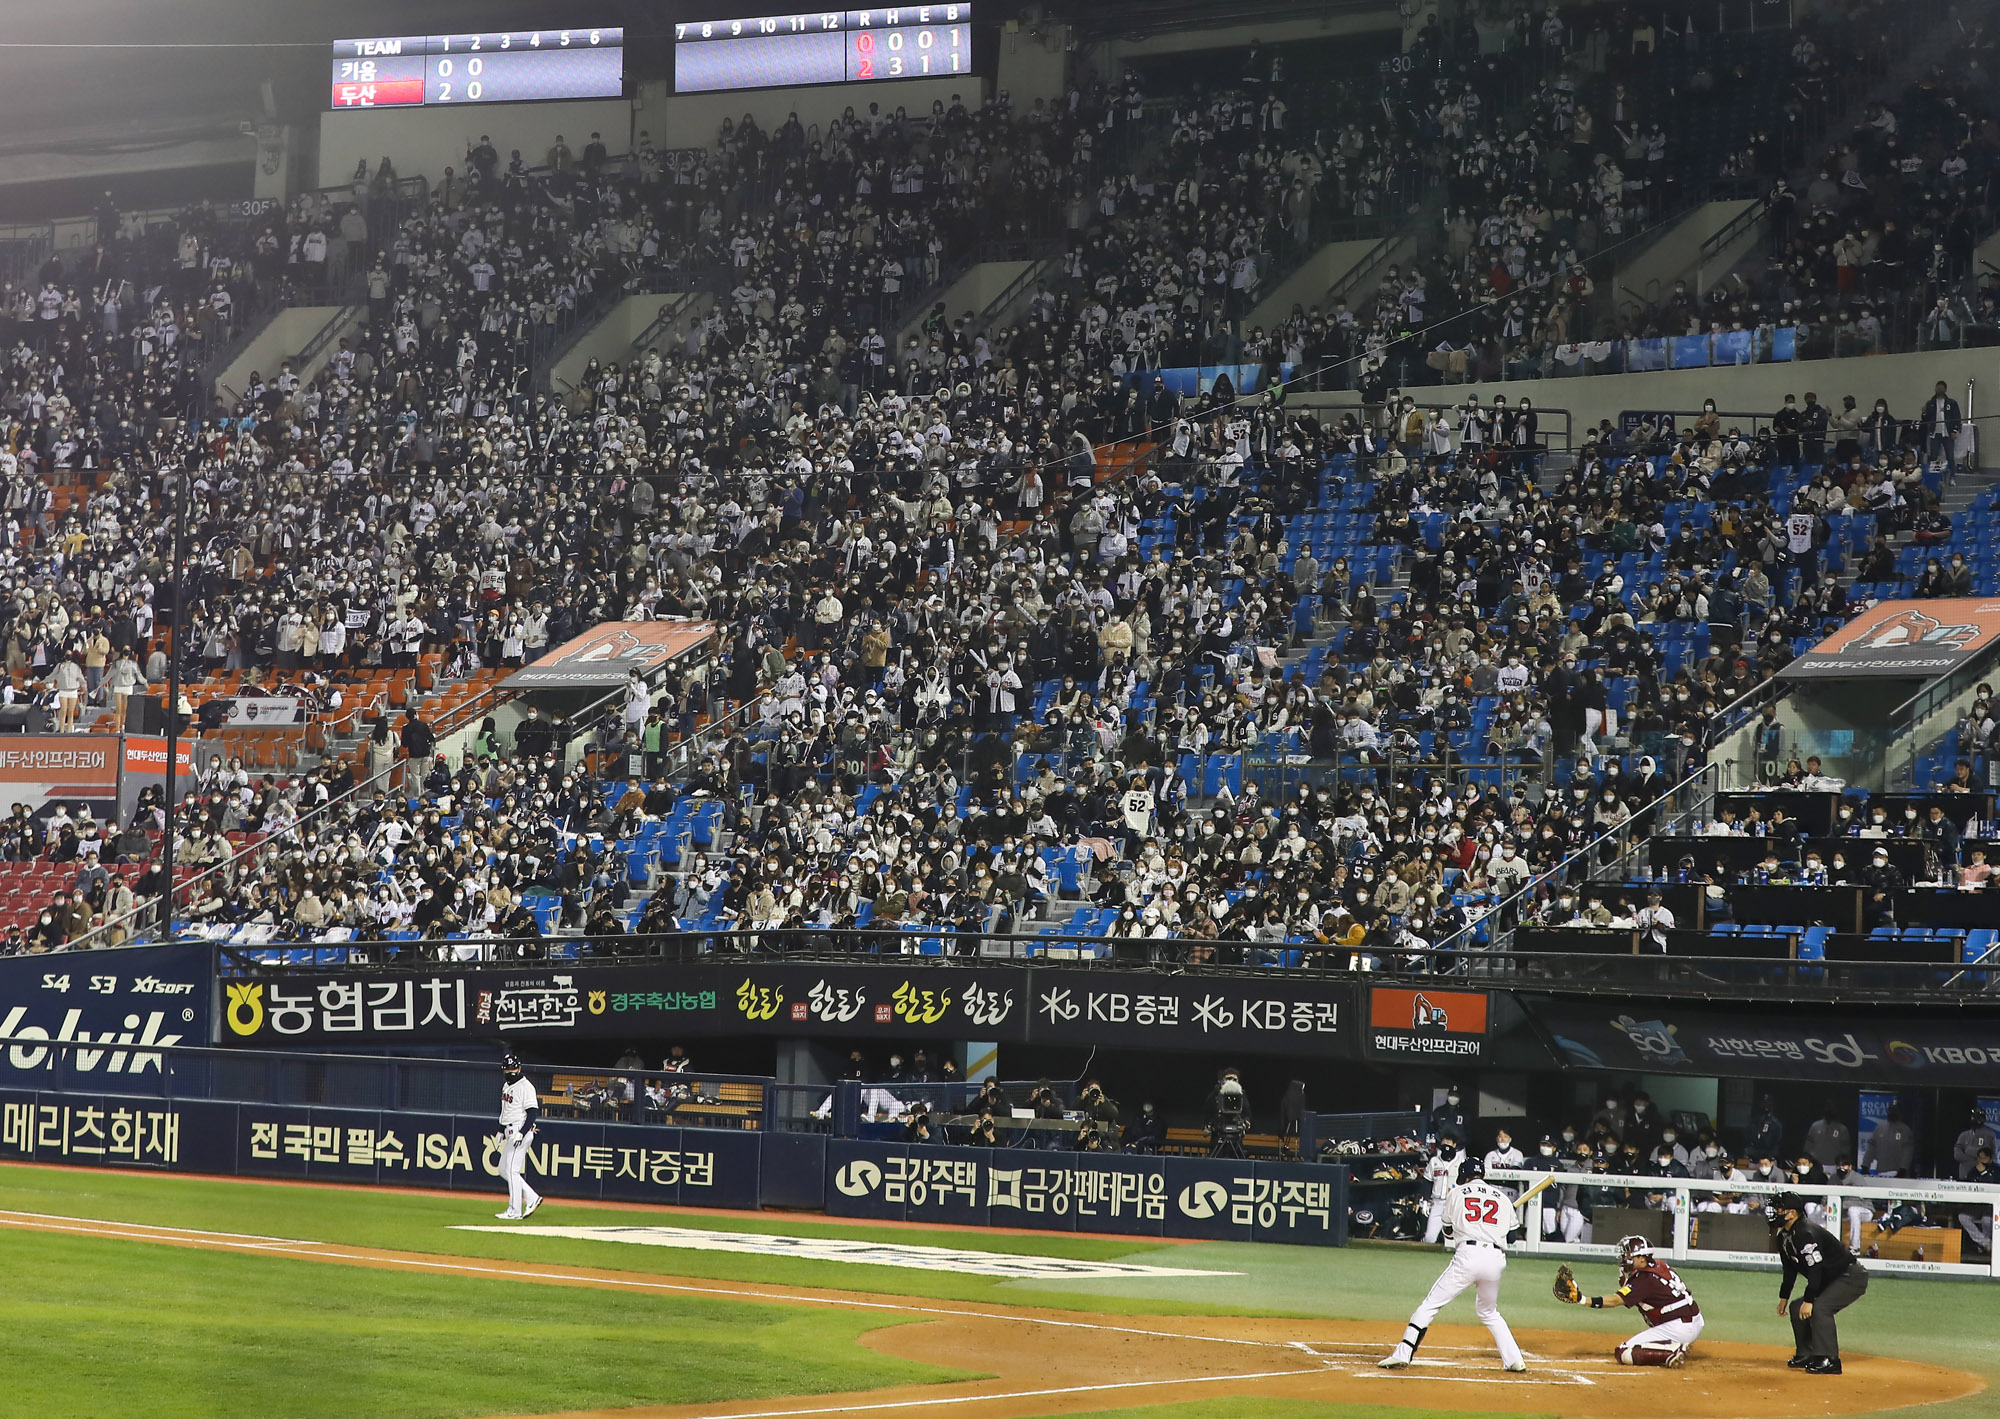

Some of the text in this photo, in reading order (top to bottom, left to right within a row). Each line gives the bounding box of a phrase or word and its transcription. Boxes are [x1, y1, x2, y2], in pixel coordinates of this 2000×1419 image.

[676, 6, 958, 39] 7 8 9 10 11 12 R H E B
[355, 30, 600, 56] TEAM 1 2 3 4 5 6
[857, 29, 959, 53] 0 0 0 1
[341, 58, 483, 82] 키움 0 0
[858, 53, 959, 78] 2 3 1 1
[340, 82, 482, 107] 두산 2 0
[1233, 429, 1246, 440] 52
[1793, 524, 1807, 535] 52
[1527, 575, 1538, 586] 10
[954, 664, 964, 675] 10
[127, 749, 190, 765] 현대두산인프코어
[1129, 799, 1146, 812] 52
[1496, 867, 1518, 876] BEARS
[41, 974, 71, 992] S4
[89, 976, 117, 994] S3
[268, 978, 466, 1035] 농협김치
[477, 992, 492, 1024] 경주
[494, 989, 582, 1030] 천년한우
[611, 991, 716, 1012] 경주축산농협
[1087, 992, 1179, 1025] KB증권
[1241, 1000, 1338, 1033] KB증권
[1375, 1036, 1480, 1056] 현대두산인프라코어
[1708, 1037, 1800, 1060] 신한은행
[1862, 1101, 1889, 1109] POCA
[1862, 1108, 1889, 1116] SWEA
[3, 1103, 180, 1162] 메리츠화재
[416, 1133, 473, 1172] ISA
[524, 1143, 715, 1186] NH투자증권
[884, 1157, 977, 1207] 금강주택
[1023, 1168, 1168, 1219] 금강펜테리움
[1231, 1178, 1330, 1230] 금강주택
[1464, 1197, 1499, 1225] 52
